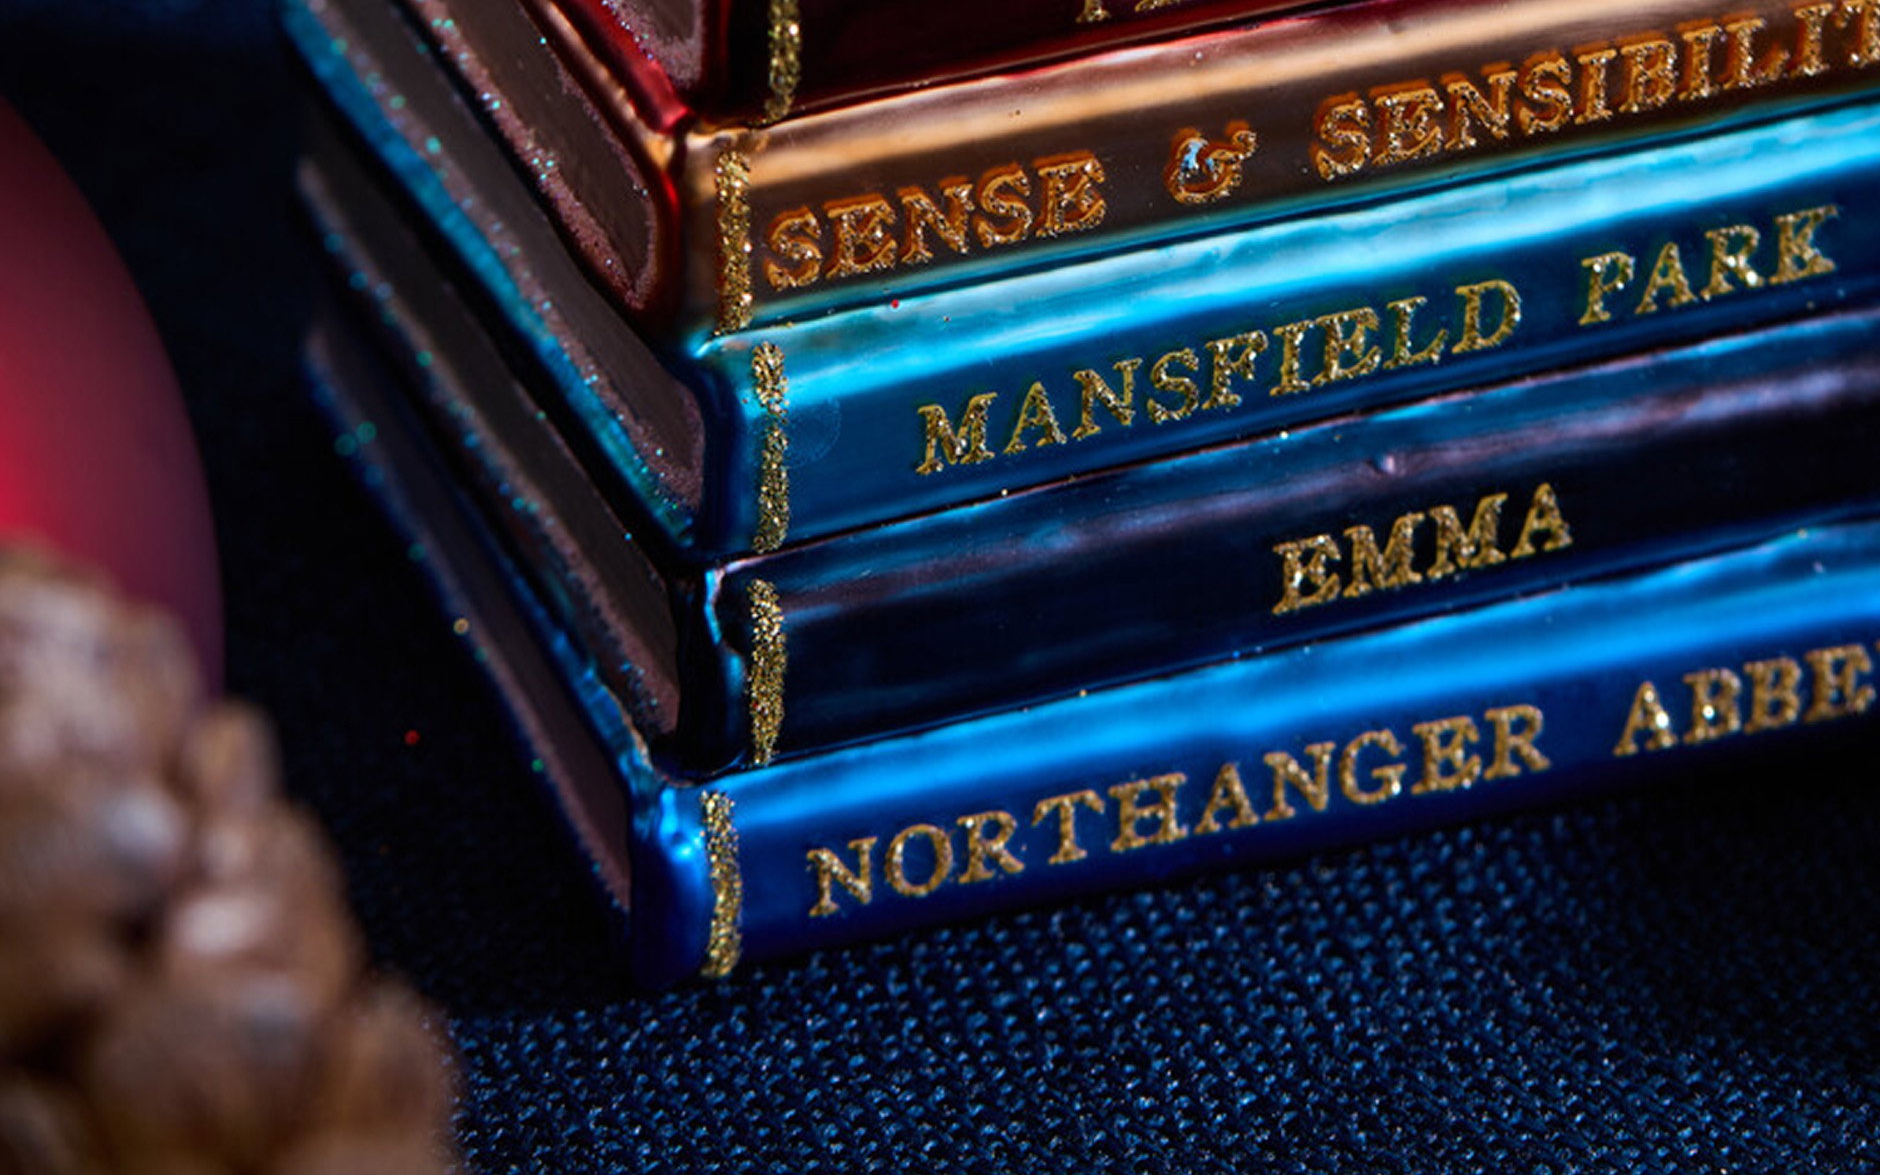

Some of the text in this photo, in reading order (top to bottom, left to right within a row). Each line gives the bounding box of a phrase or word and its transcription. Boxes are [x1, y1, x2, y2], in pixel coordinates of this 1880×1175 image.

[765, 153, 1107, 292] SENSE
[1170, 127, 1258, 205] &
[916, 203, 1838, 475] MANSFIELD PARK
[1271, 482, 1574, 615] EMMA
[806, 639, 1880, 918] NORTHANGER ABBE
